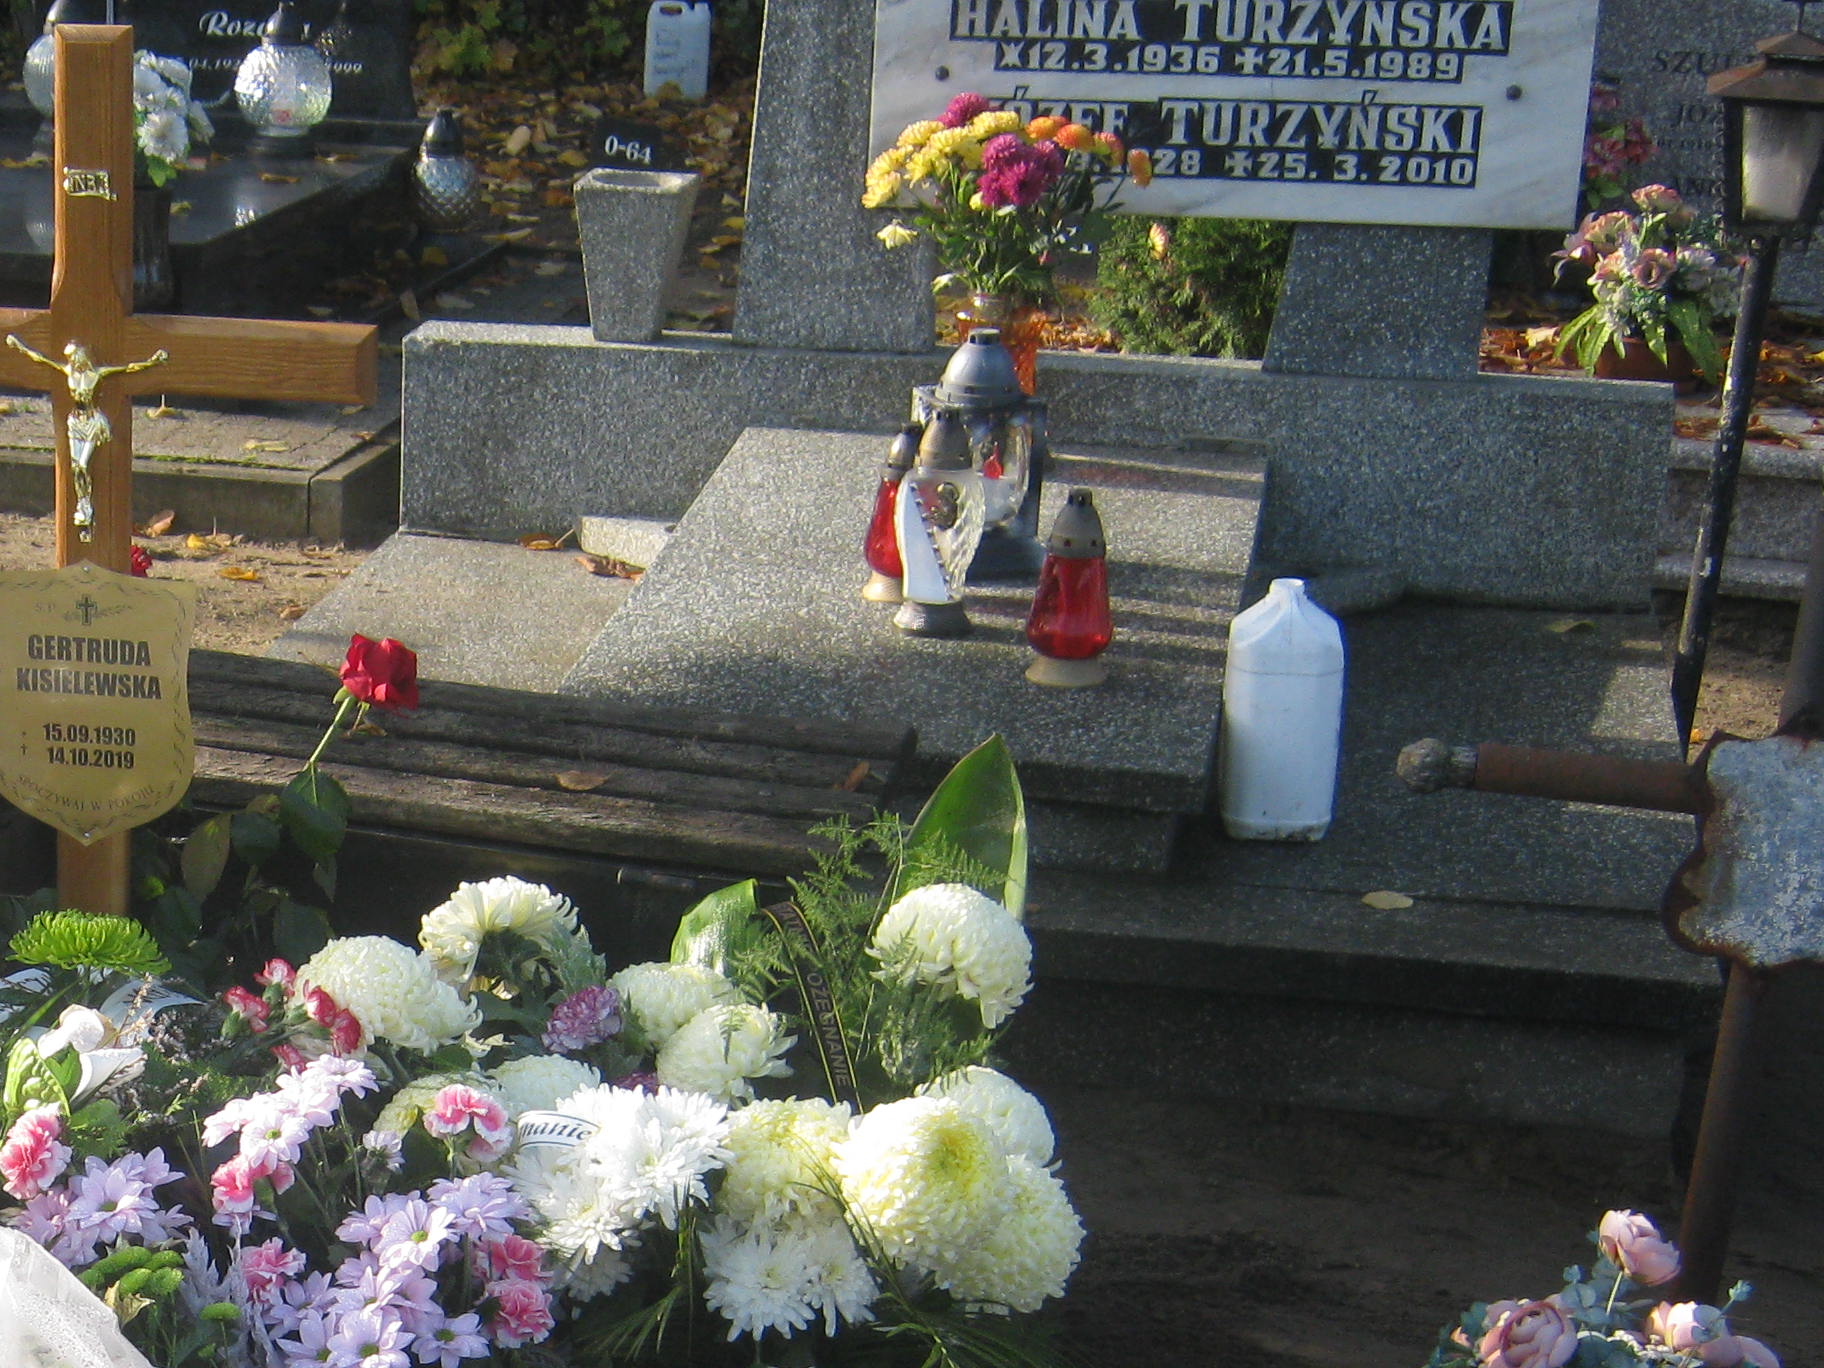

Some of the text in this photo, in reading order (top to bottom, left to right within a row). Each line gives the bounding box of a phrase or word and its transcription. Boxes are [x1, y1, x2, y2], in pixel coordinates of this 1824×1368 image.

[953, 0, 1141, 40] HALINA
[1161, 90, 1480, 153] TURZYŃSKI
[28, 634, 151, 666] GERTRUDA
[16, 668, 162, 700] KISIELEWSKA
[43, 723, 136, 746] 15.09.1930
[47, 747, 135, 769] 14.10.2019
